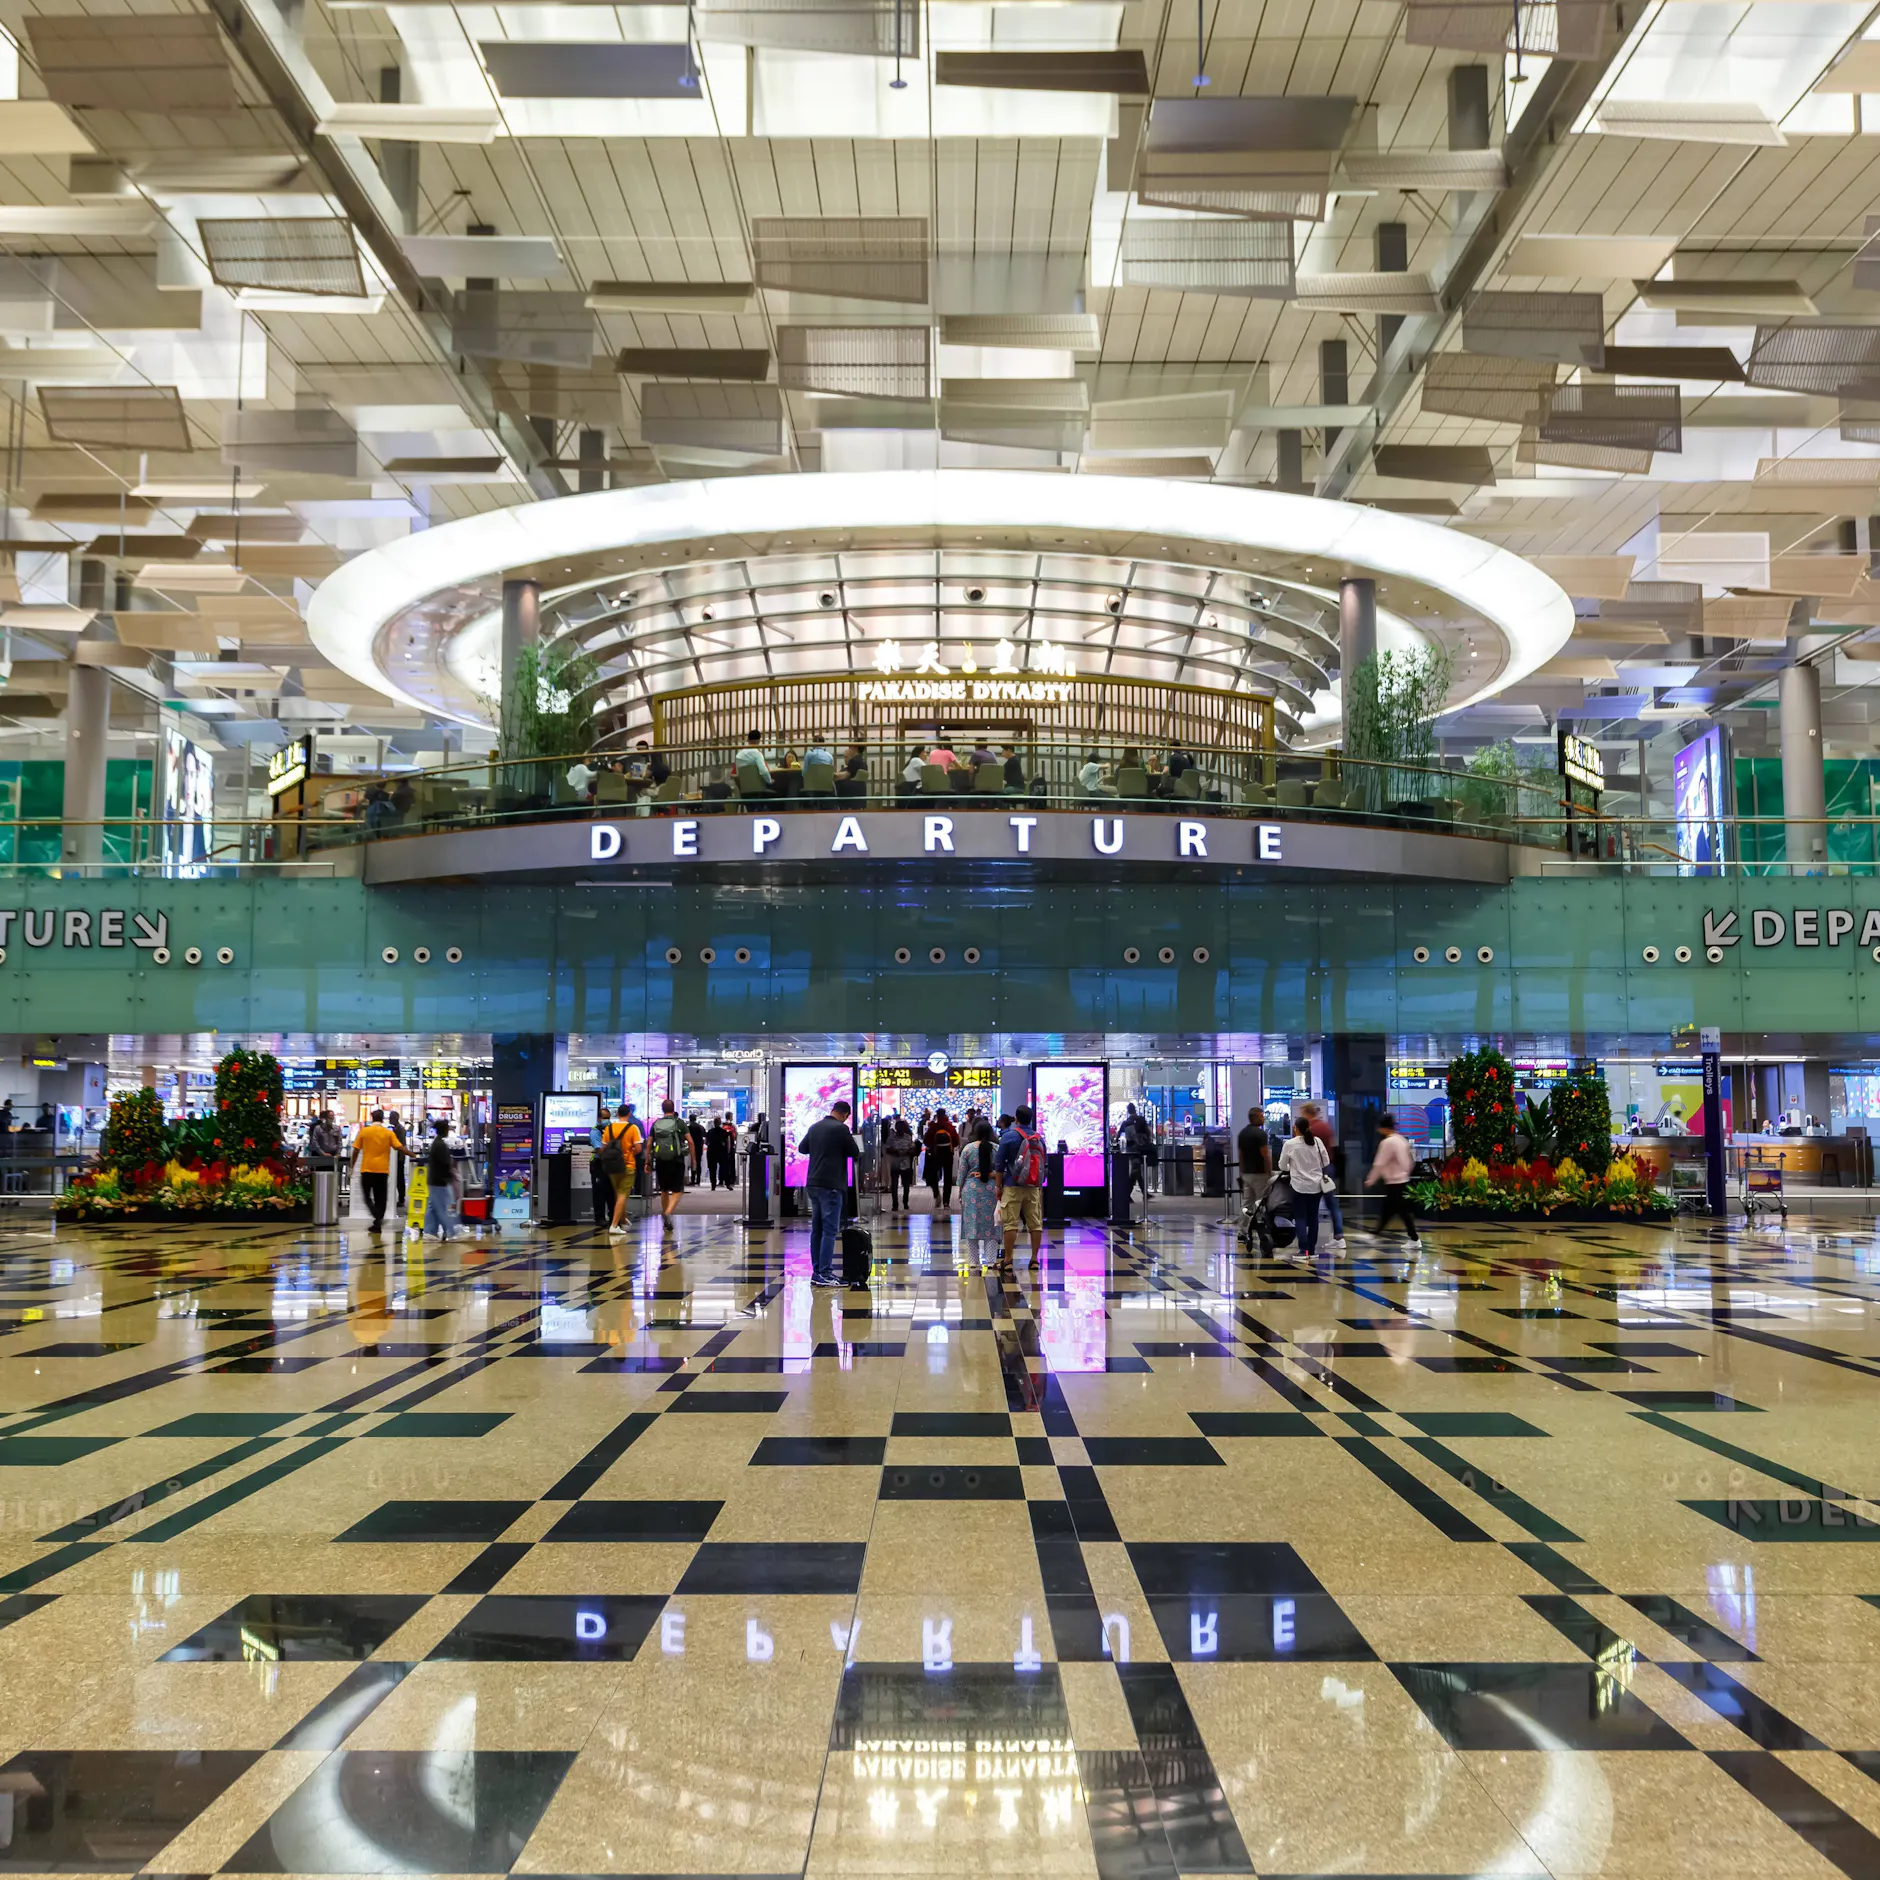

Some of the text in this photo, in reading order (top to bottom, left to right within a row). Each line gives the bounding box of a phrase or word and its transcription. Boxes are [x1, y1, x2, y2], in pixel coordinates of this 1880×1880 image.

[858, 683, 1071, 701] PARADISE DYNASTY
[590, 816, 1284, 861] DEPARTURE
[1752, 909, 1880, 947] DEPA
[1705, 1056, 1713, 1095] Trolleys
